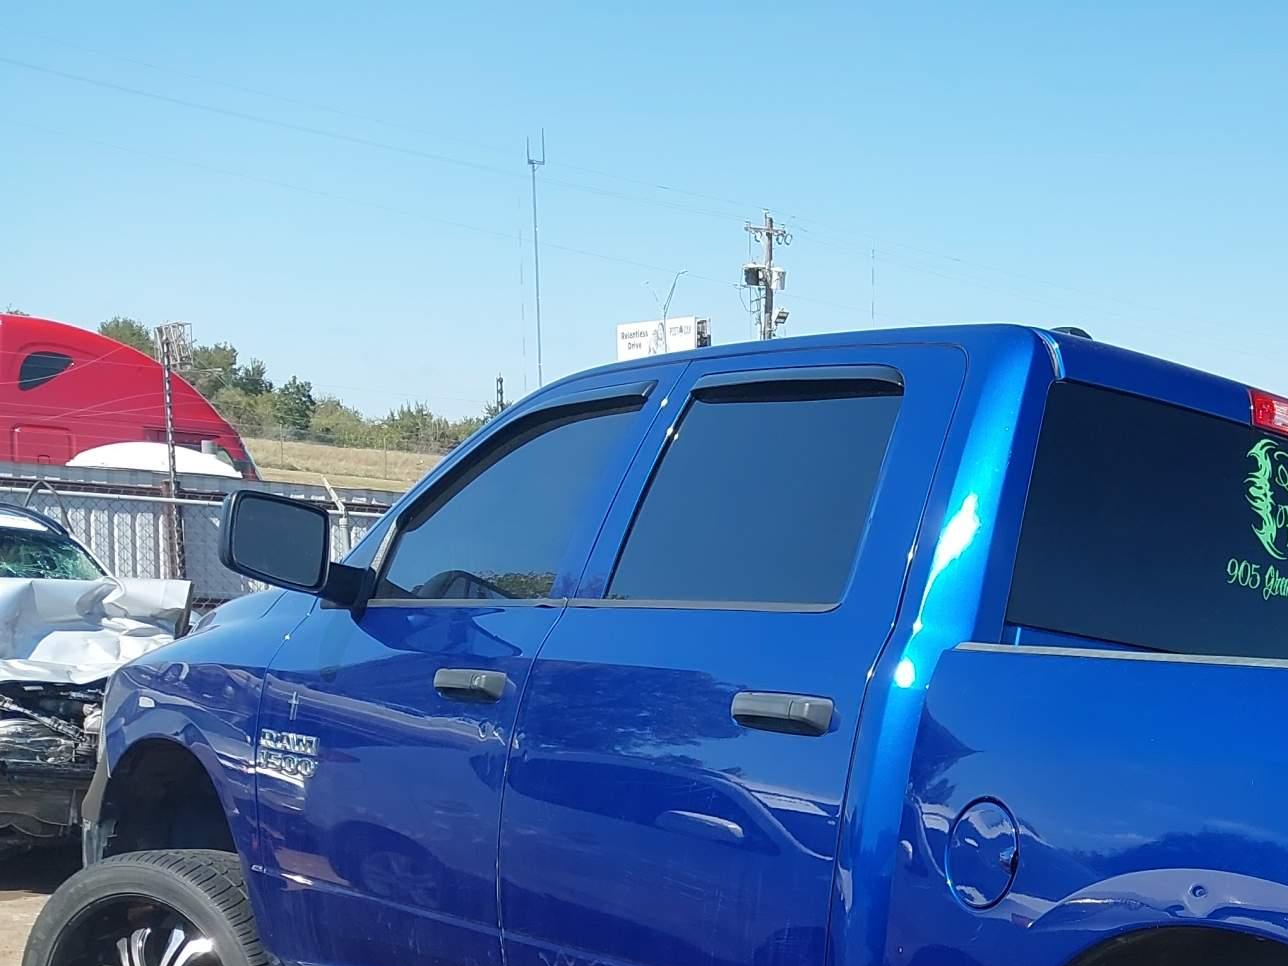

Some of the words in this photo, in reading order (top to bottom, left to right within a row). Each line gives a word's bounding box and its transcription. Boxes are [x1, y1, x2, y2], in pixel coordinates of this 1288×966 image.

[628, 342, 642, 350] Drive
[1227, 558, 1261, 589] 905
[260, 728, 320, 756] RAM
[258, 750, 316, 778] 1500
